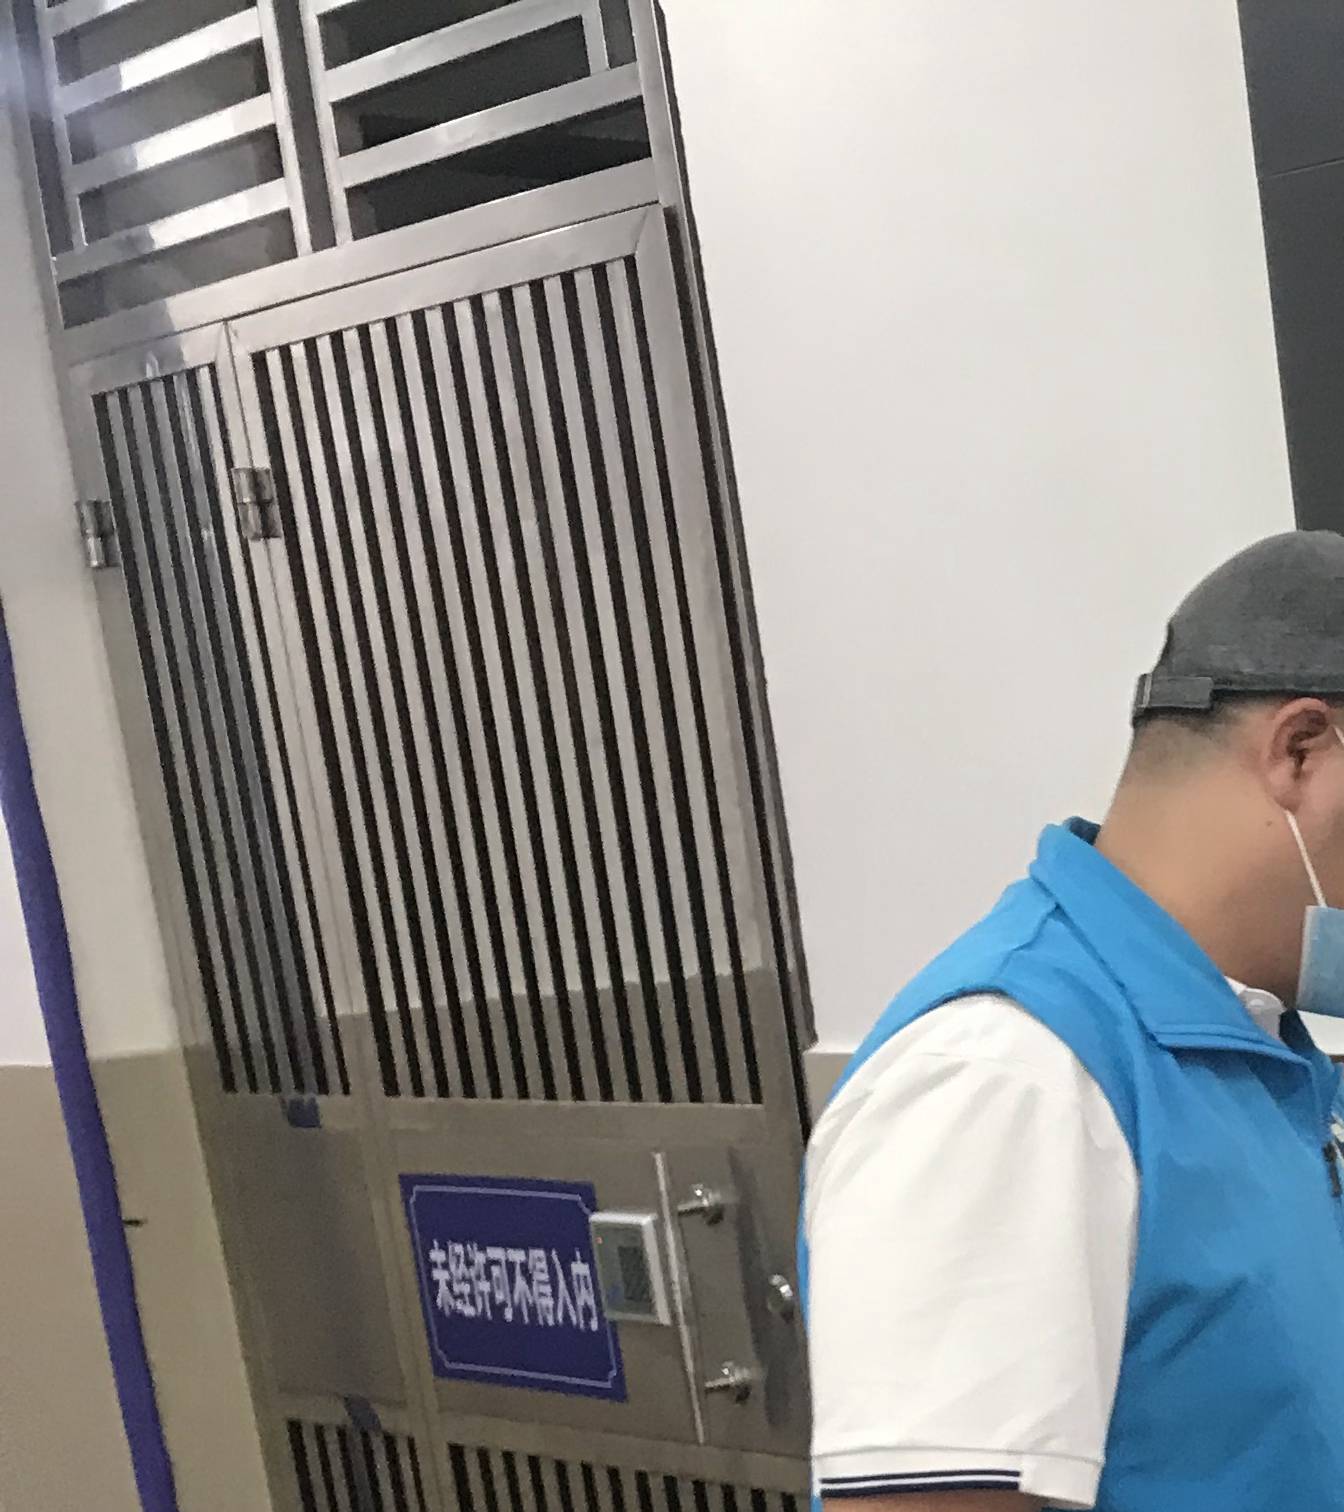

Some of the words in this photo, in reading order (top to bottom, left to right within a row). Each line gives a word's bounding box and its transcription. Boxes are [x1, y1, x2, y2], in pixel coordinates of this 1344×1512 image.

[428, 1239, 599, 1332] 未经许可不得入内
